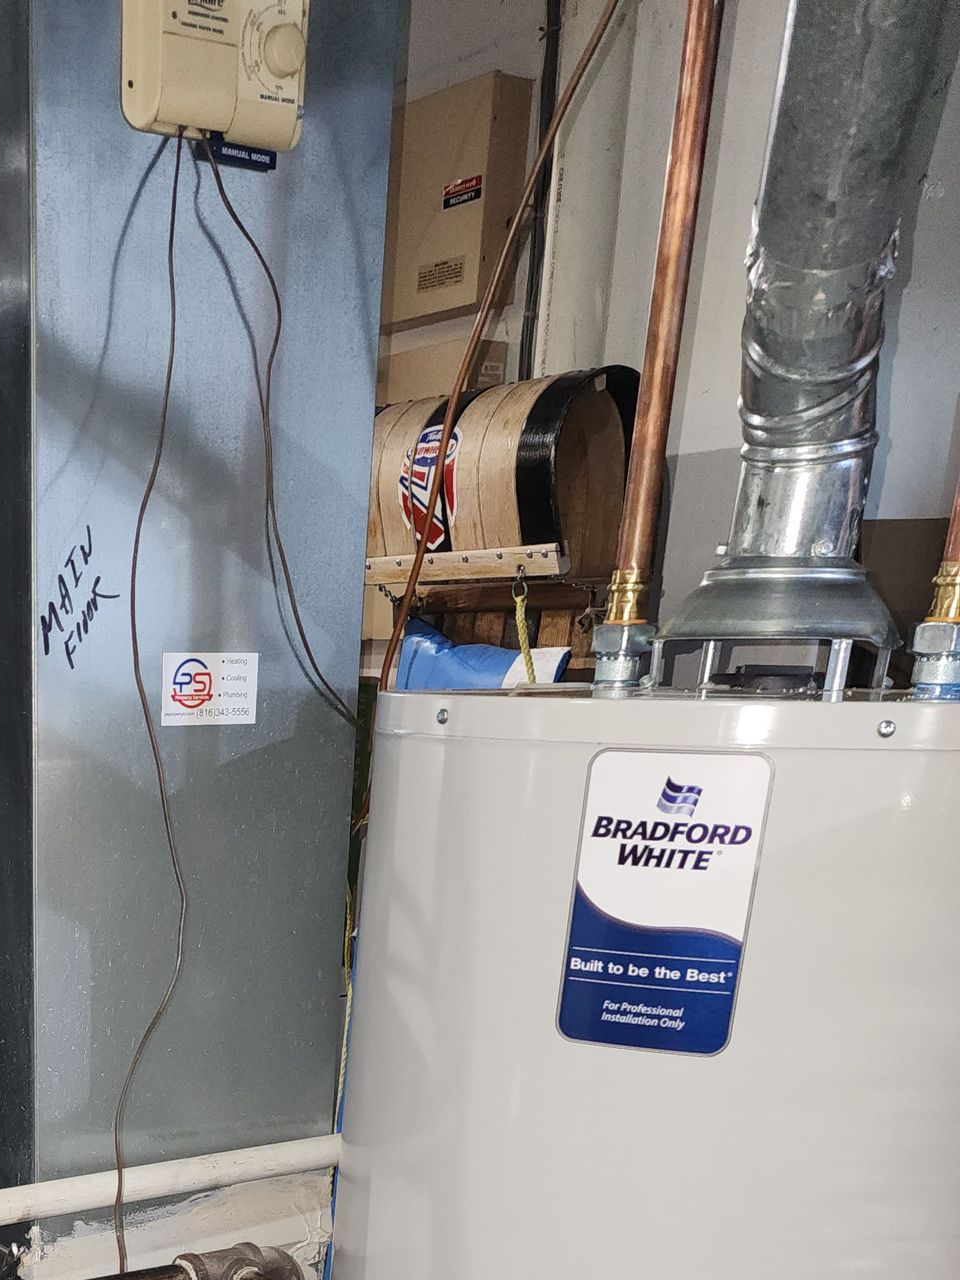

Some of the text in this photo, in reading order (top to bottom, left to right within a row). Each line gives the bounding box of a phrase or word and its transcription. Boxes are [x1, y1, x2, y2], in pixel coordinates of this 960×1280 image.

[222, 147, 270, 164] MANUAL MODE
[450, 191, 475, 205] SECURITY
[40, 525, 92, 655] MAIN
[226, 657, 247, 665] Heating
[226, 674, 247, 683] Cooling
[223, 691, 247, 699] Plumbing
[196, 707, 249, 718] (816)343-5556
[591, 816, 752, 845] BRADFORD
[618, 844, 713, 870] WHITE
[570, 957, 726, 983] Built to be the Best
[603, 1000, 684, 1017] For Professional
[601, 1011, 685, 1031] Installation Only
